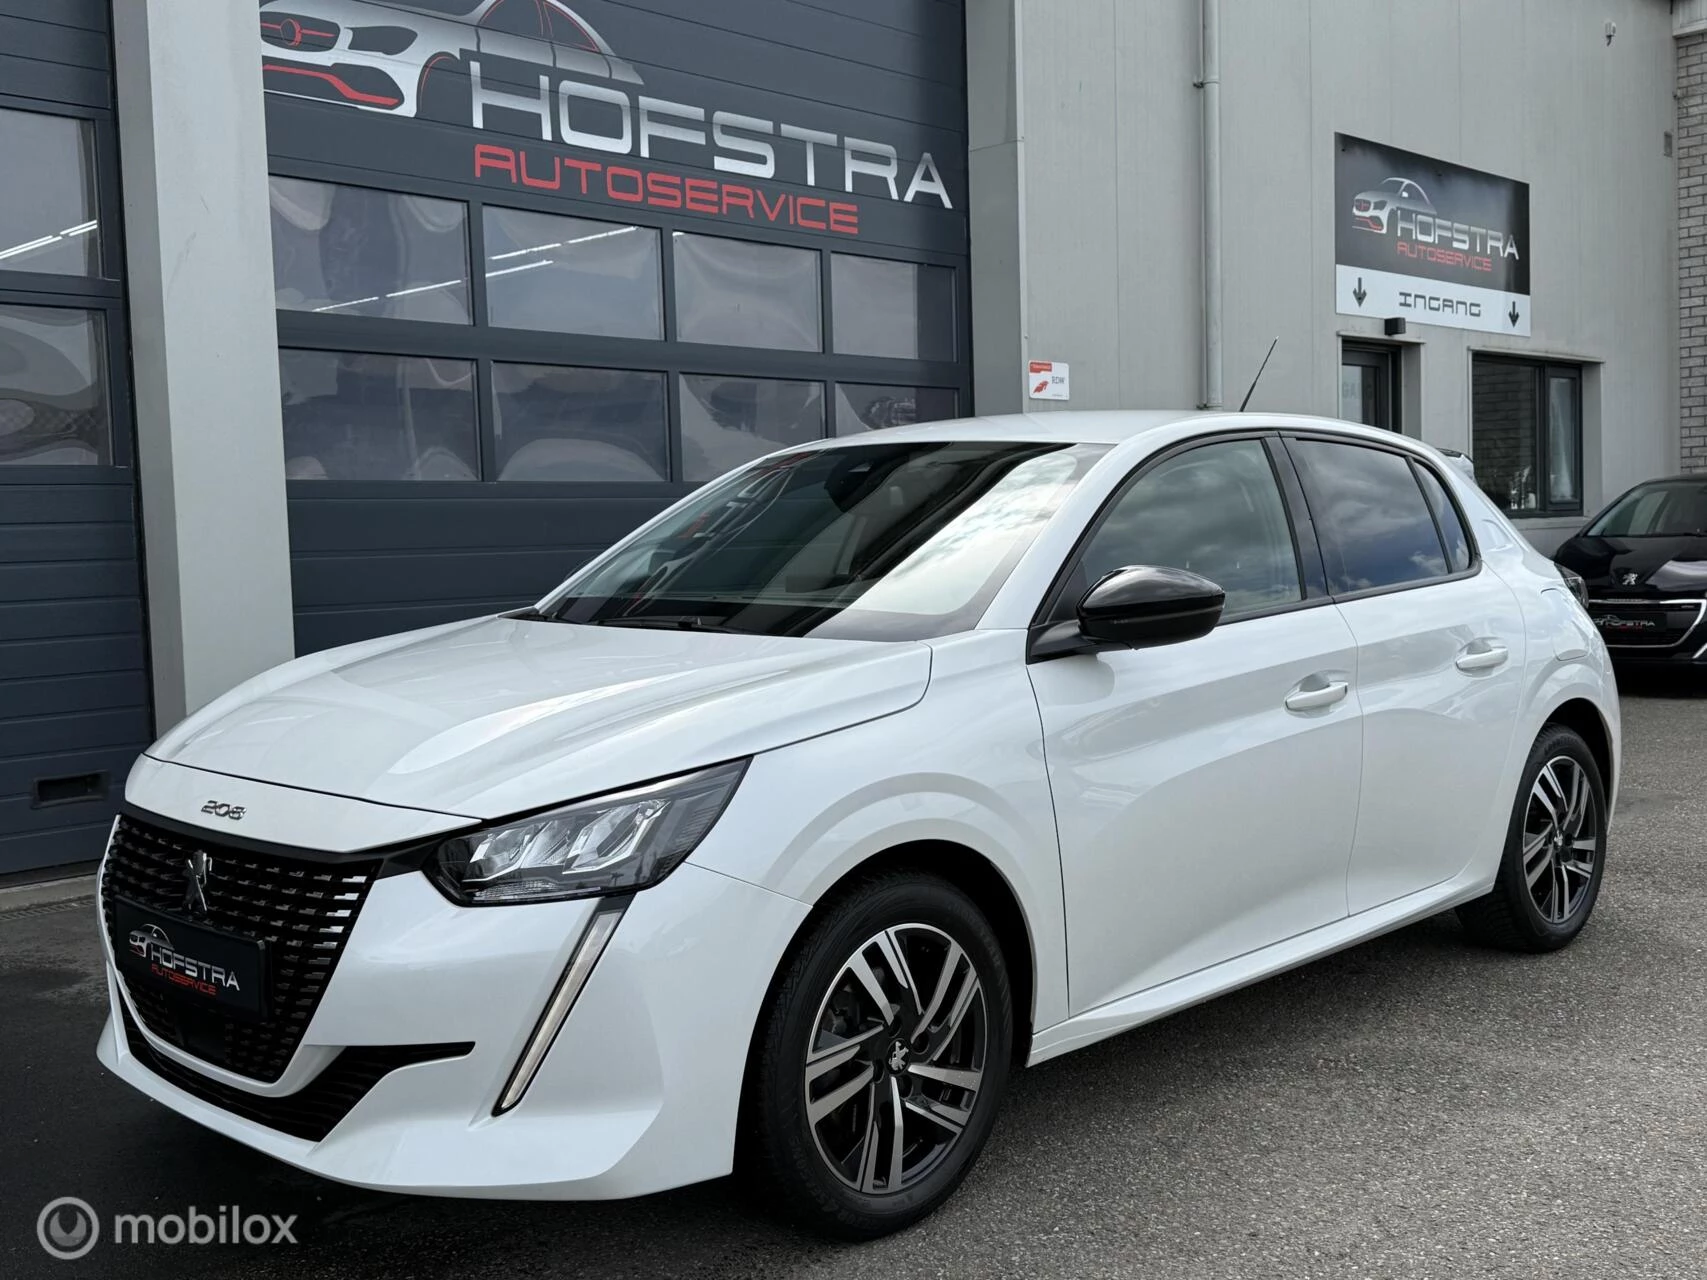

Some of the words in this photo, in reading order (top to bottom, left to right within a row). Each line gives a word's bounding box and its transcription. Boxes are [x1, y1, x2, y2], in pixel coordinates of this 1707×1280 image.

[470, 60, 953, 209] HOFSTRA
[474, 144, 859, 235] AUTOSERVICE
[1396, 209, 1519, 261] HOFSTRA
[1396, 241, 1492, 272] AUTOSERVICE
[1398, 291, 1481, 318] INGANG
[200, 800, 247, 821] 208
[151, 943, 240, 991] HOFSTRA
[152, 964, 217, 996] AUTOSERVICE
